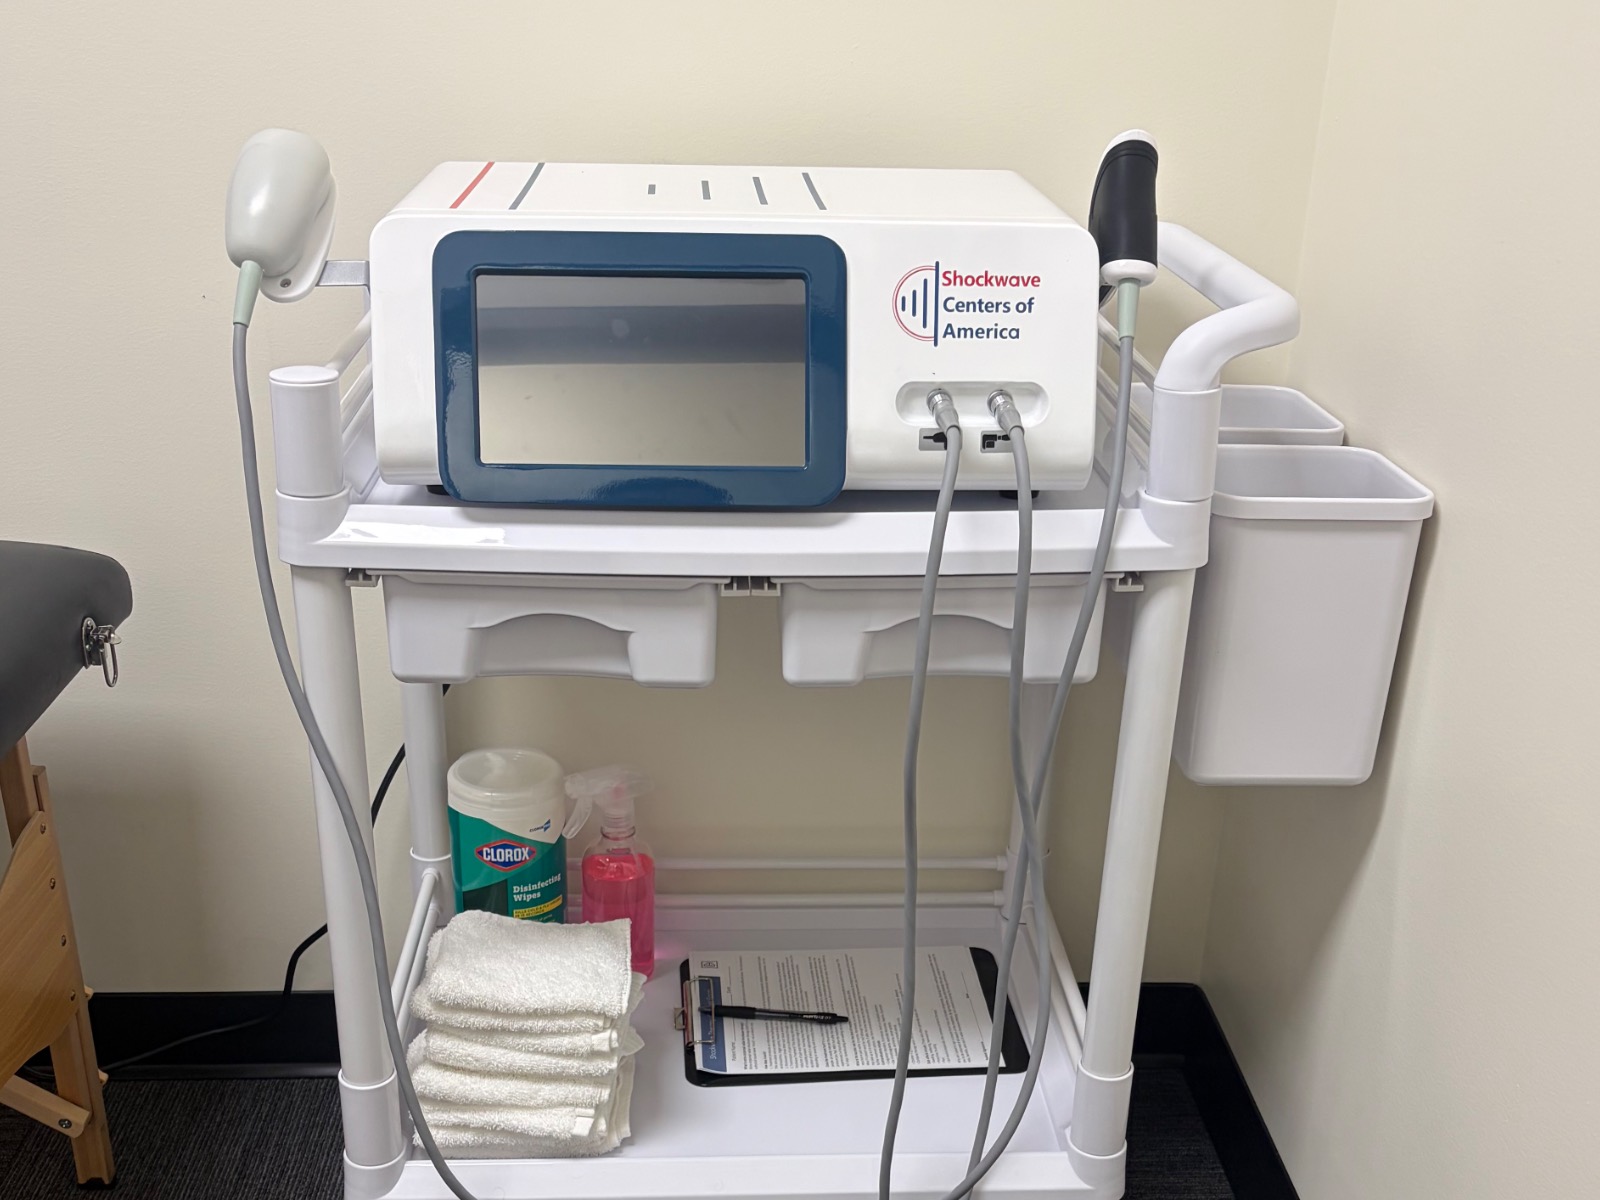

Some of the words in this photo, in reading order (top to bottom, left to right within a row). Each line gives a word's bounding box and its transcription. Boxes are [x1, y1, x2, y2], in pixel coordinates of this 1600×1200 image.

[942, 270, 1041, 287] Shockwave
[943, 296, 1011, 313] Centers
[1015, 297, 1035, 313] of
[942, 323, 1020, 339] America
[482, 847, 530, 863] CLOROX
[513, 873, 561, 893] Disinfecting
[513, 892, 541, 902] Wipes
